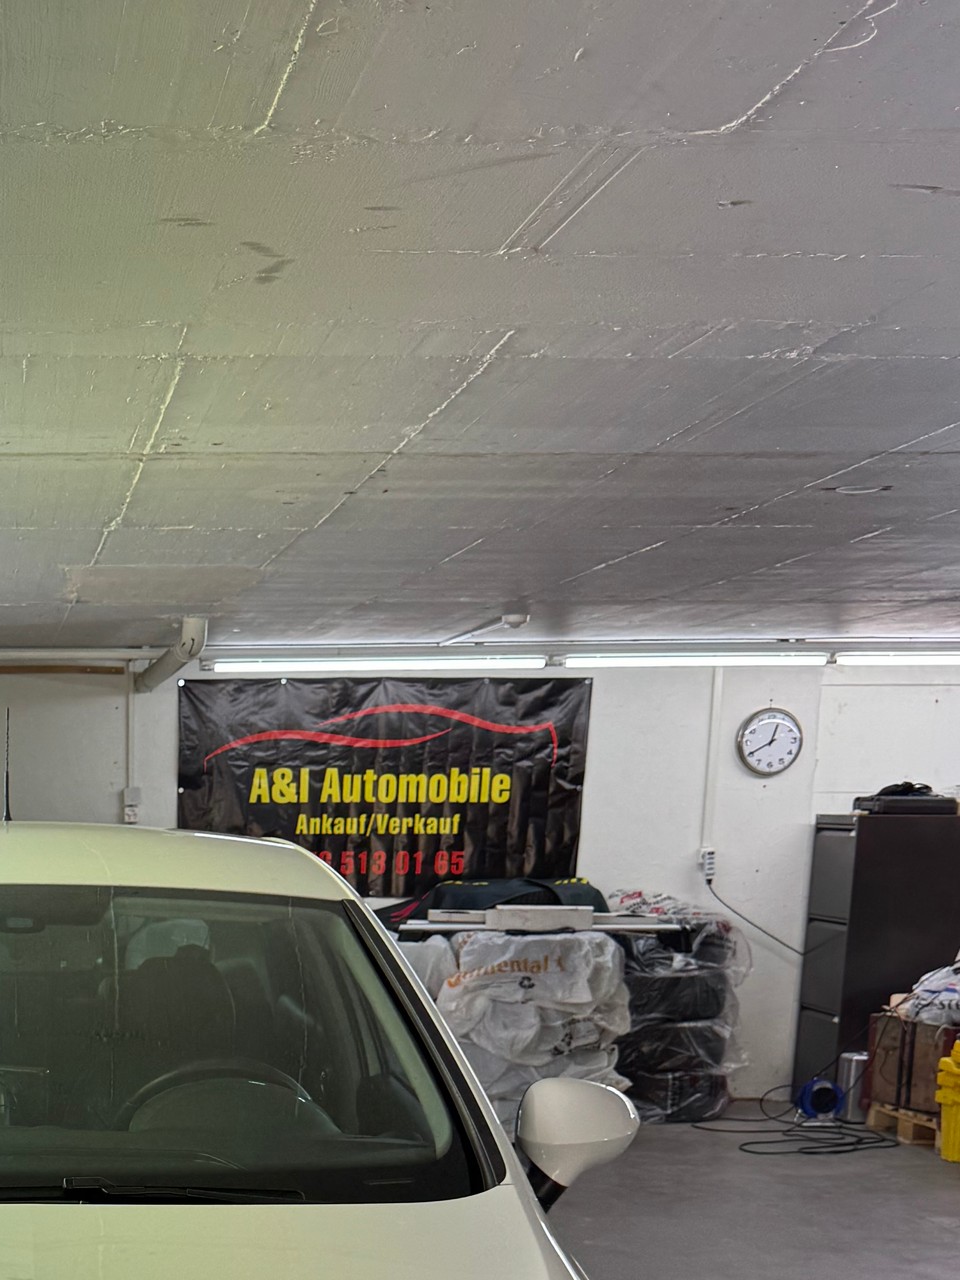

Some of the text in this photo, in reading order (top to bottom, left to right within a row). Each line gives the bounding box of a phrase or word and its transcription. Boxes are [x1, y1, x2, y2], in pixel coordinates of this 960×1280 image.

[248, 767, 511, 804] A&I Automobile
[295, 813, 461, 837] Ankauf/Verkauf
[340, 850, 387, 876] 513
[395, 850, 423, 876] 01
[433, 850, 465, 876] 65
